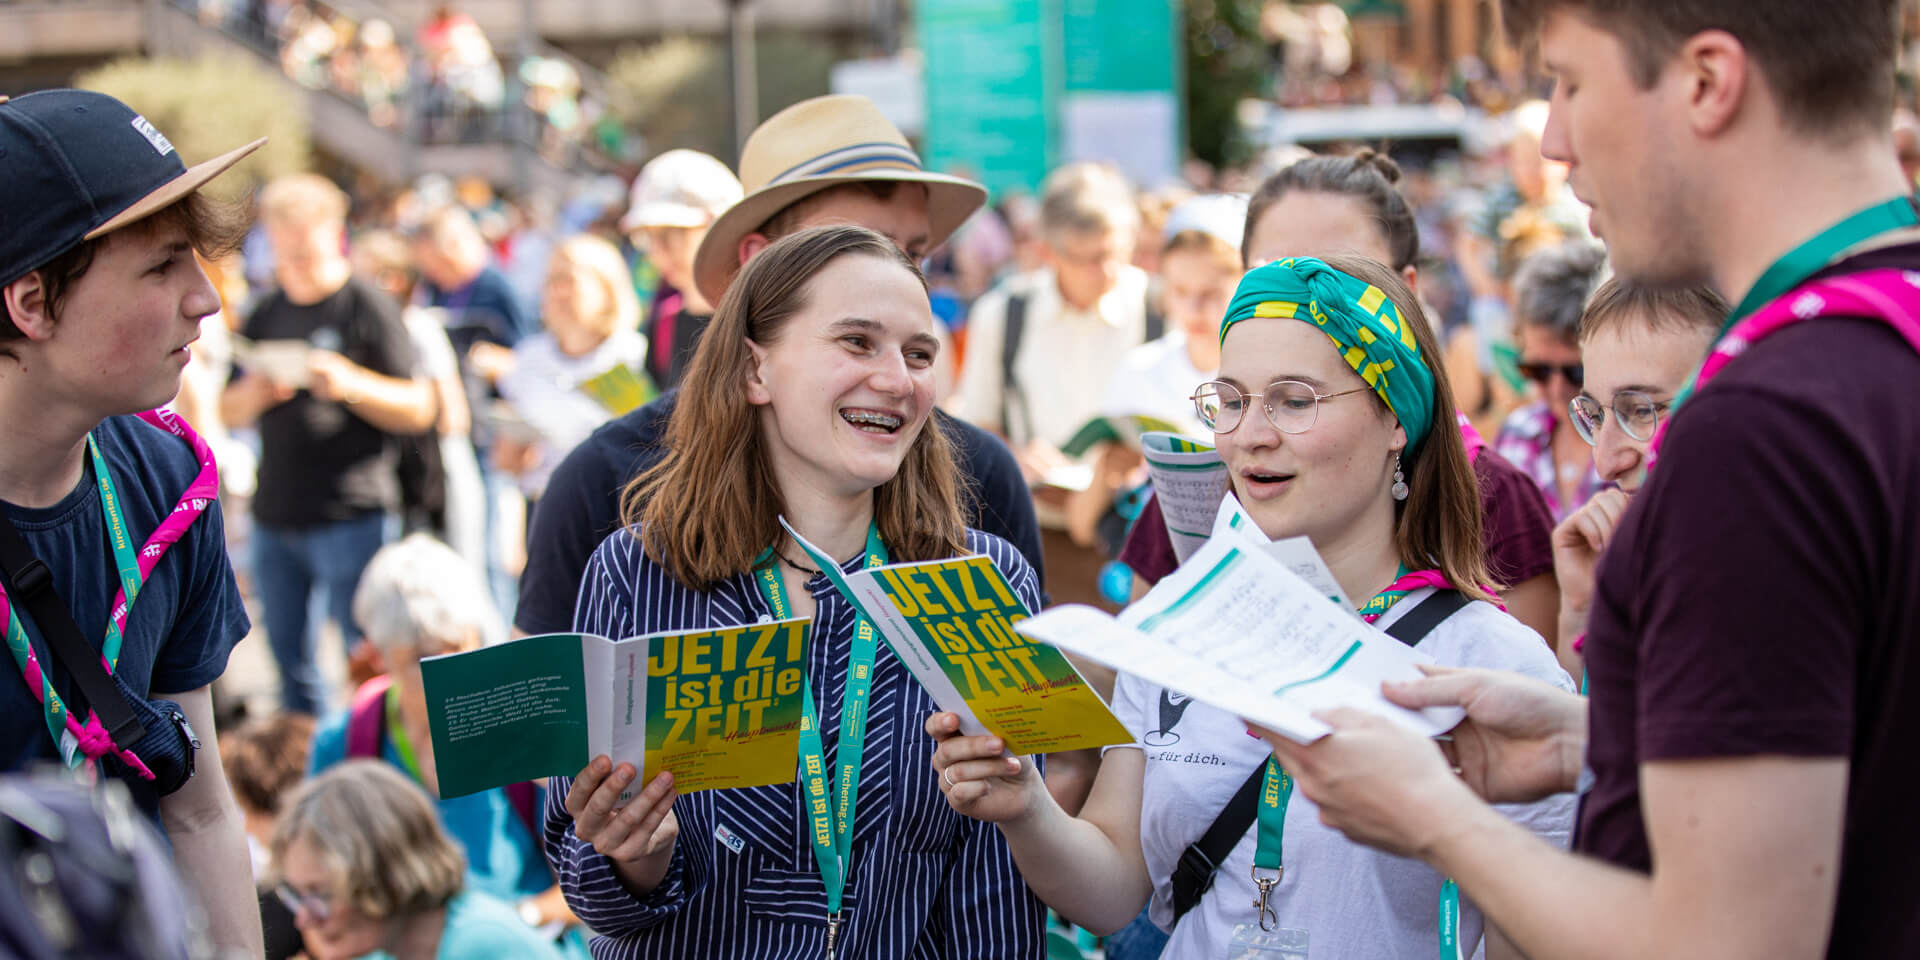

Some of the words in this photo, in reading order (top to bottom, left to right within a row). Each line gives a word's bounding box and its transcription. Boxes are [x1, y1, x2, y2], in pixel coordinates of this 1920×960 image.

[764, 568, 786, 620] chentag.de
[880, 557, 1016, 618] JETZT
[648, 619, 810, 677] JETZT
[920, 616, 985, 654] ist
[665, 675, 723, 709] ist
[733, 666, 801, 702] die
[947, 648, 1047, 700] ZEIT
[662, 698, 772, 749] ZEIT
[805, 754, 821, 776] ZEIT
[1159, 752, 1181, 762] für
[1184, 753, 1226, 766] dich.
[808, 778, 825, 795] die
[812, 796, 827, 815] ist
[838, 765, 854, 835] kirchentag.de
[1265, 777, 1279, 808] JETZT
[815, 817, 831, 847] JETZT
